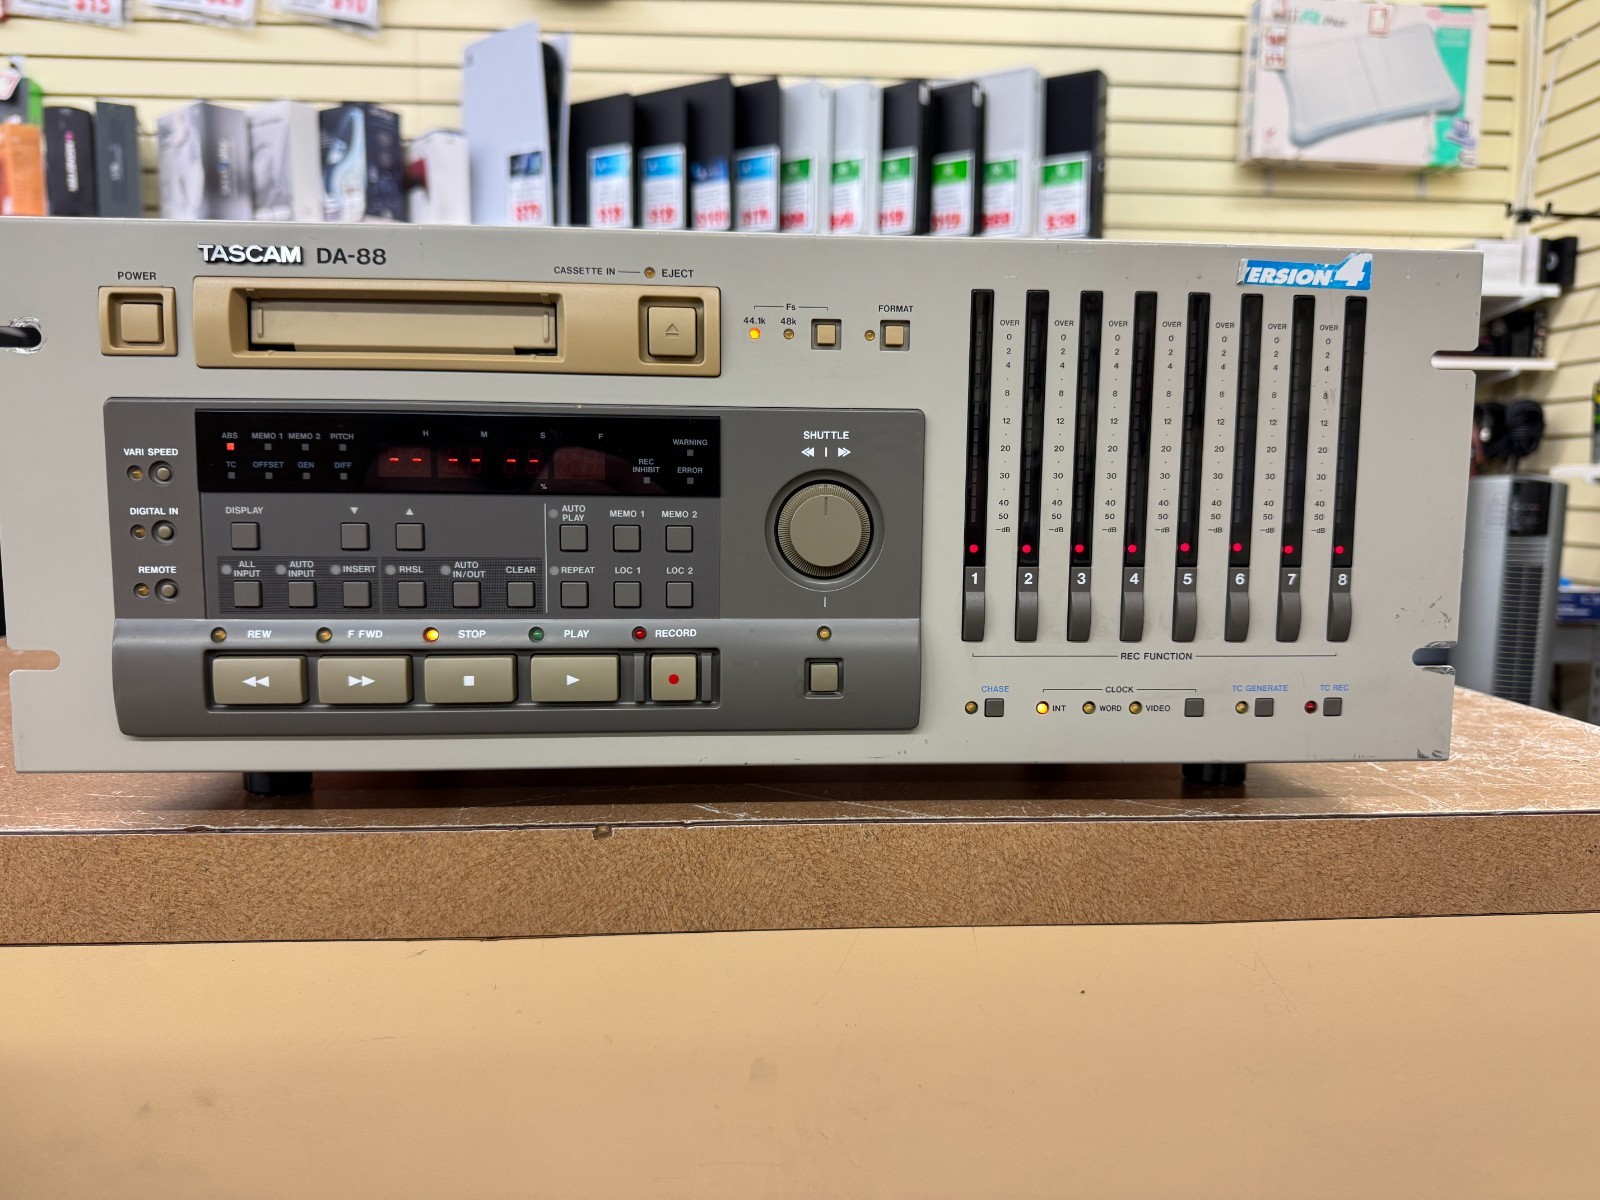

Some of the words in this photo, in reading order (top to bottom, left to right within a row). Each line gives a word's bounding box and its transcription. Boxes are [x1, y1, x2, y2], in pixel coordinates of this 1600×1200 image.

[197, 244, 303, 264] TASCAM
[316, 247, 387, 266] DA-88
[117, 271, 157, 281] POWER
[553, 266, 603, 276] CASSETTE
[606, 267, 616, 276] IN
[661, 268, 695, 279] EJECT
[785, 303, 796, 311] Fs
[878, 304, 914, 313] FORMAT
[743, 316, 766, 325] 44.1k
[780, 317, 797, 326] 48k
[999, 319, 1020, 327] OVER
[1053, 319, 1074, 327] OVER
[1108, 320, 1129, 328] OVER
[1161, 320, 1182, 328] OVER
[1215, 321, 1235, 329] OVER
[1267, 322, 1287, 330] OVER
[1319, 324, 1339, 332] OVER
[1006, 333, 1013, 341] 0
[1060, 333, 1067, 342] 0
[1114, 334, 1121, 342] 0
[1168, 334, 1175, 342] 0
[1221, 335, 1228, 343] 0
[1273, 336, 1280, 344] 0
[1325, 337, 1332, 346] 0
[1006, 347, 1012, 355] 2
[1060, 347, 1066, 355] 2
[1114, 348, 1120, 356] 2
[1168, 348, 1174, 356] 2
[1221, 349, 1227, 357] 2
[1273, 350, 1279, 358] 2
[1005, 361, 1011, 369] 4
[1059, 361, 1065, 369] 4
[1167, 362, 1173, 370] 4
[1220, 363, 1226, 371] 4
[1004, 389, 1010, 397] 8
[1058, 389, 1064, 397] 8
[1112, 389, 1118, 398] 8
[1165, 390, 1172, 398] 8
[1002, 417, 1011, 425] 12
[1056, 417, 1065, 425] 12
[1109, 417, 1119, 425] 12
[1163, 417, 1172, 425] 12
[1216, 418, 1225, 426] 12
[1268, 418, 1278, 426] 12
[1319, 419, 1329, 427] 12
[221, 431, 239, 440] ABS
[251, 432, 277, 440] MEMO
[278, 432, 283, 440] 1
[287, 432, 314, 440] MEMO
[315, 432, 321, 440] 2
[330, 432, 355, 441] PITCH
[422, 429, 429, 437] H
[480, 430, 488, 438] M
[539, 431, 546, 440] S
[803, 430, 850, 440] SHUTTLE
[672, 438, 708, 446] WARNING
[123, 447, 145, 456] VARI
[147, 447, 179, 457] SPEED
[1000, 444, 1011, 452] 20
[1053, 444, 1065, 453] 20
[1107, 445, 1119, 453] 20
[1160, 445, 1172, 453] 20
[1213, 445, 1225, 453] 20
[1266, 446, 1277, 454] 20
[1317, 446, 1328, 454] 20
[225, 460, 237, 469] TC
[252, 460, 285, 469] OFFSET
[297, 461, 315, 469] GEN
[333, 461, 353, 469] DIFF
[638, 458, 655, 466] REC
[677, 466, 704, 474] ERROR
[999, 472, 1010, 480] 30
[1052, 472, 1064, 480] 30
[1106, 472, 1117, 480] 30
[1159, 472, 1171, 480] 30
[1212, 472, 1224, 480] 30
[1264, 472, 1276, 481] 30
[1315, 473, 1327, 481] 30
[998, 499, 1010, 507] 40
[1051, 499, 1063, 507] 40
[1104, 499, 1116, 507] 40
[1158, 499, 1170, 507] 40
[1210, 499, 1222, 507] 40
[1314, 500, 1325, 508] 40
[129, 507, 167, 516] DIGITAL
[168, 507, 179, 515] IN
[225, 506, 264, 515] DISPLAY
[561, 504, 586, 513] AUTO
[562, 513, 585, 522] PLAY
[609, 509, 638, 518] MEMO
[640, 510, 645, 518] 1
[661, 510, 689, 519] MEMO
[692, 510, 698, 519] 2
[998, 512, 1009, 520] 50
[1262, 513, 1273, 521] 50
[1313, 513, 1324, 521] 50
[238, 560, 257, 568] ALL
[289, 560, 315, 569] AUTO
[454, 560, 479, 569] AUTO
[138, 565, 177, 574] REMOTE
[342, 565, 377, 573] INSERT
[398, 565, 424, 574] RHSL
[505, 565, 537, 574] CLEAR
[560, 566, 596, 574] REPEAT
[614, 566, 633, 575] LOC
[636, 566, 641, 575] 1
[666, 566, 685, 575] LOC
[687, 566, 694, 575] 2
[233, 569, 261, 578] INPUT
[288, 569, 316, 578] INPUT
[452, 570, 487, 579] IN/OUT
[971, 572, 978, 585] 1
[1023, 572, 1033, 585] 2
[1076, 572, 1087, 585] 3
[1129, 572, 1140, 585] 4
[1182, 573, 1193, 585] 5
[1235, 572, 1245, 586] 6
[1287, 573, 1297, 586] 7
[1337, 573, 1348, 586] 8
[247, 629, 272, 639] REW
[347, 629, 355, 639] F
[358, 629, 383, 639] FWD
[458, 629, 487, 639] STOP
[563, 629, 590, 639] PLAY
[654, 628, 697, 638] RECORD
[1120, 652, 1140, 661] REC
[1143, 652, 1193, 661] FUNCTION
[981, 685, 1010, 693] CHASE
[1104, 685, 1134, 694] CLOCK
[1231, 684, 1243, 693] TC
[1245, 684, 1289, 692] GENERATE
[1319, 684, 1331, 692] TC
[1332, 683, 1350, 692] REC
[1052, 704, 1067, 712] INT
[1099, 704, 1122, 712] WORD
[1145, 704, 1171, 712] VIDEO
